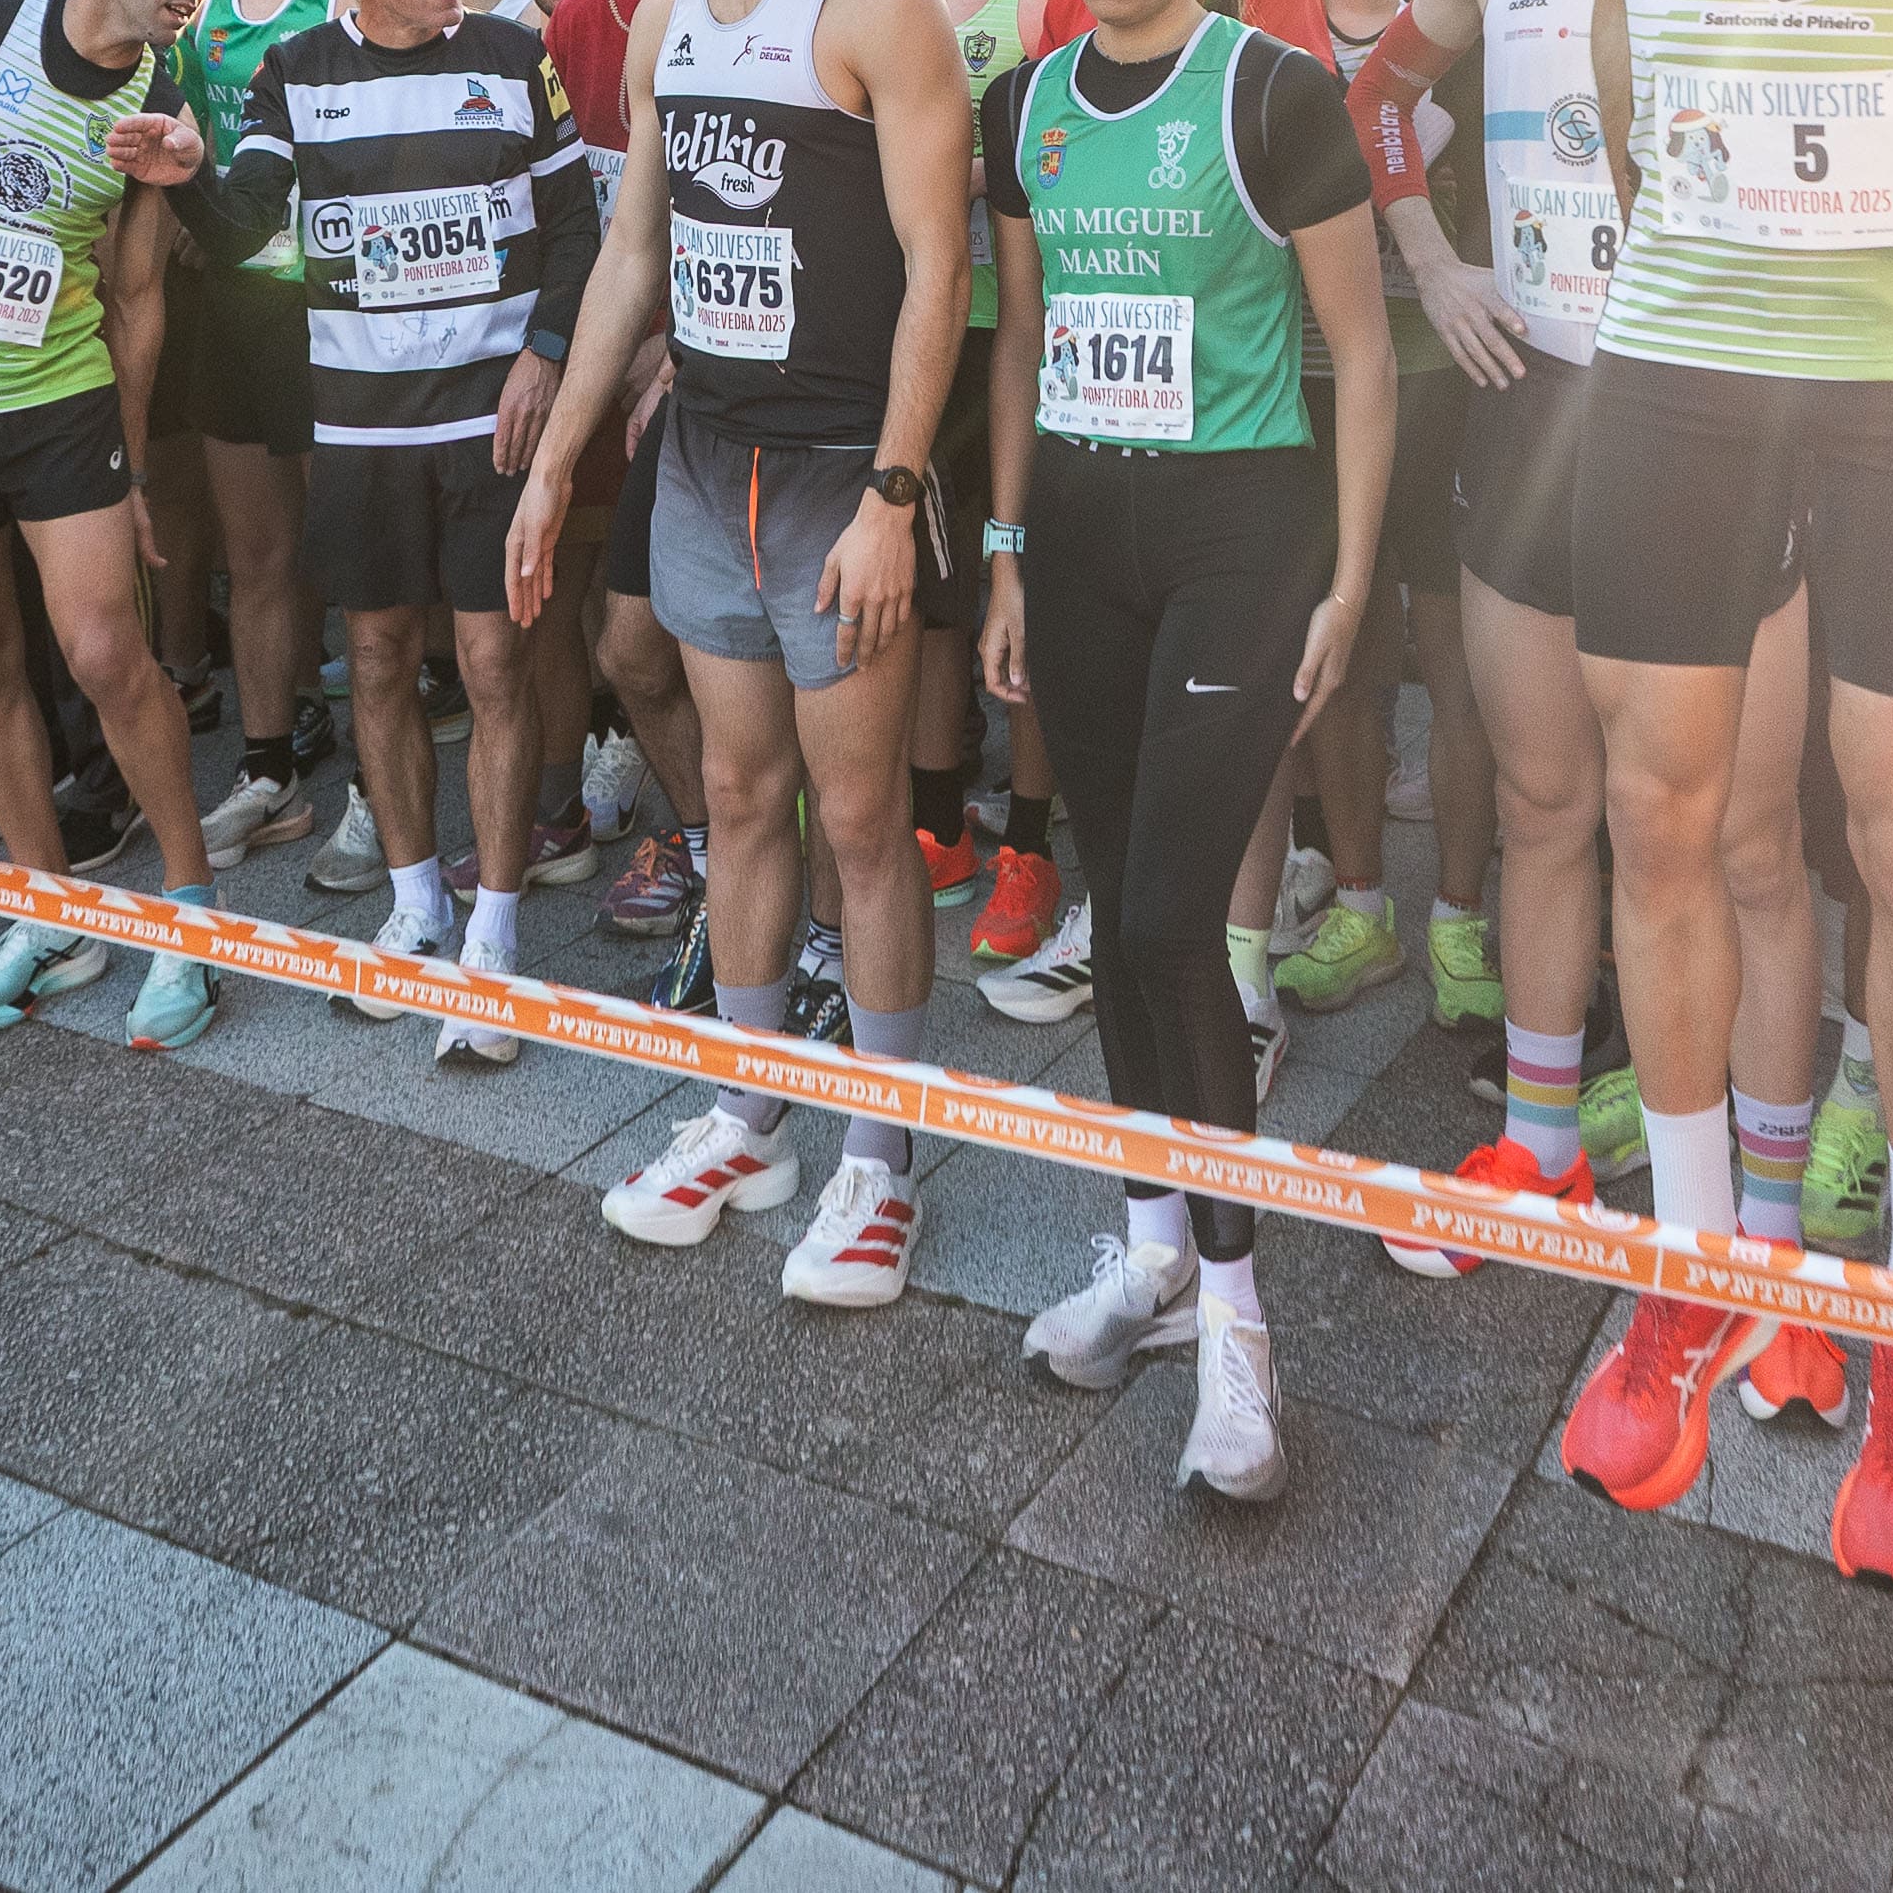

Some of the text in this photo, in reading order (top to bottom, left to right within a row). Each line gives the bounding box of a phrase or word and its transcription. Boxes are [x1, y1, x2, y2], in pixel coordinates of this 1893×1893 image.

[1704, 12, 1778, 27] Santomé
[1782, 13, 1802, 27] de
[760, 51, 791, 63] DELIKIA
[1664, 74, 1885, 117] XLII SAN SILVESTRE
[324, 108, 350, 119] OCHO
[1793, 124, 1829, 183] 5
[720, 173, 755, 193] fresh
[358, 192, 480, 227] XLII SAN SILVESTRE
[1534, 188, 1566, 217] SAN
[1738, 187, 1892, 214] PONTEVEDRA 2025
[1074, 207, 1213, 238] MIGUEL
[400, 216, 486, 263] 3054
[686, 227, 703, 255] SAN
[706, 231, 782, 262] SILVESTRE
[1591, 225, 1617, 271] 8
[404, 256, 489, 282] PONTEVEDRA 2025
[1057, 241, 1162, 276] MARÍN
[696, 259, 783, 309] 6375
[17, 305, 43, 324] 2025
[697, 307, 786, 332] PONTEVEDRA 2025
[1049, 301, 1183, 331] XLII SAN SILVESTRE
[1088, 333, 1174, 384] 1614
[1082, 386, 1183, 410] PONTEVEDRA 2025
